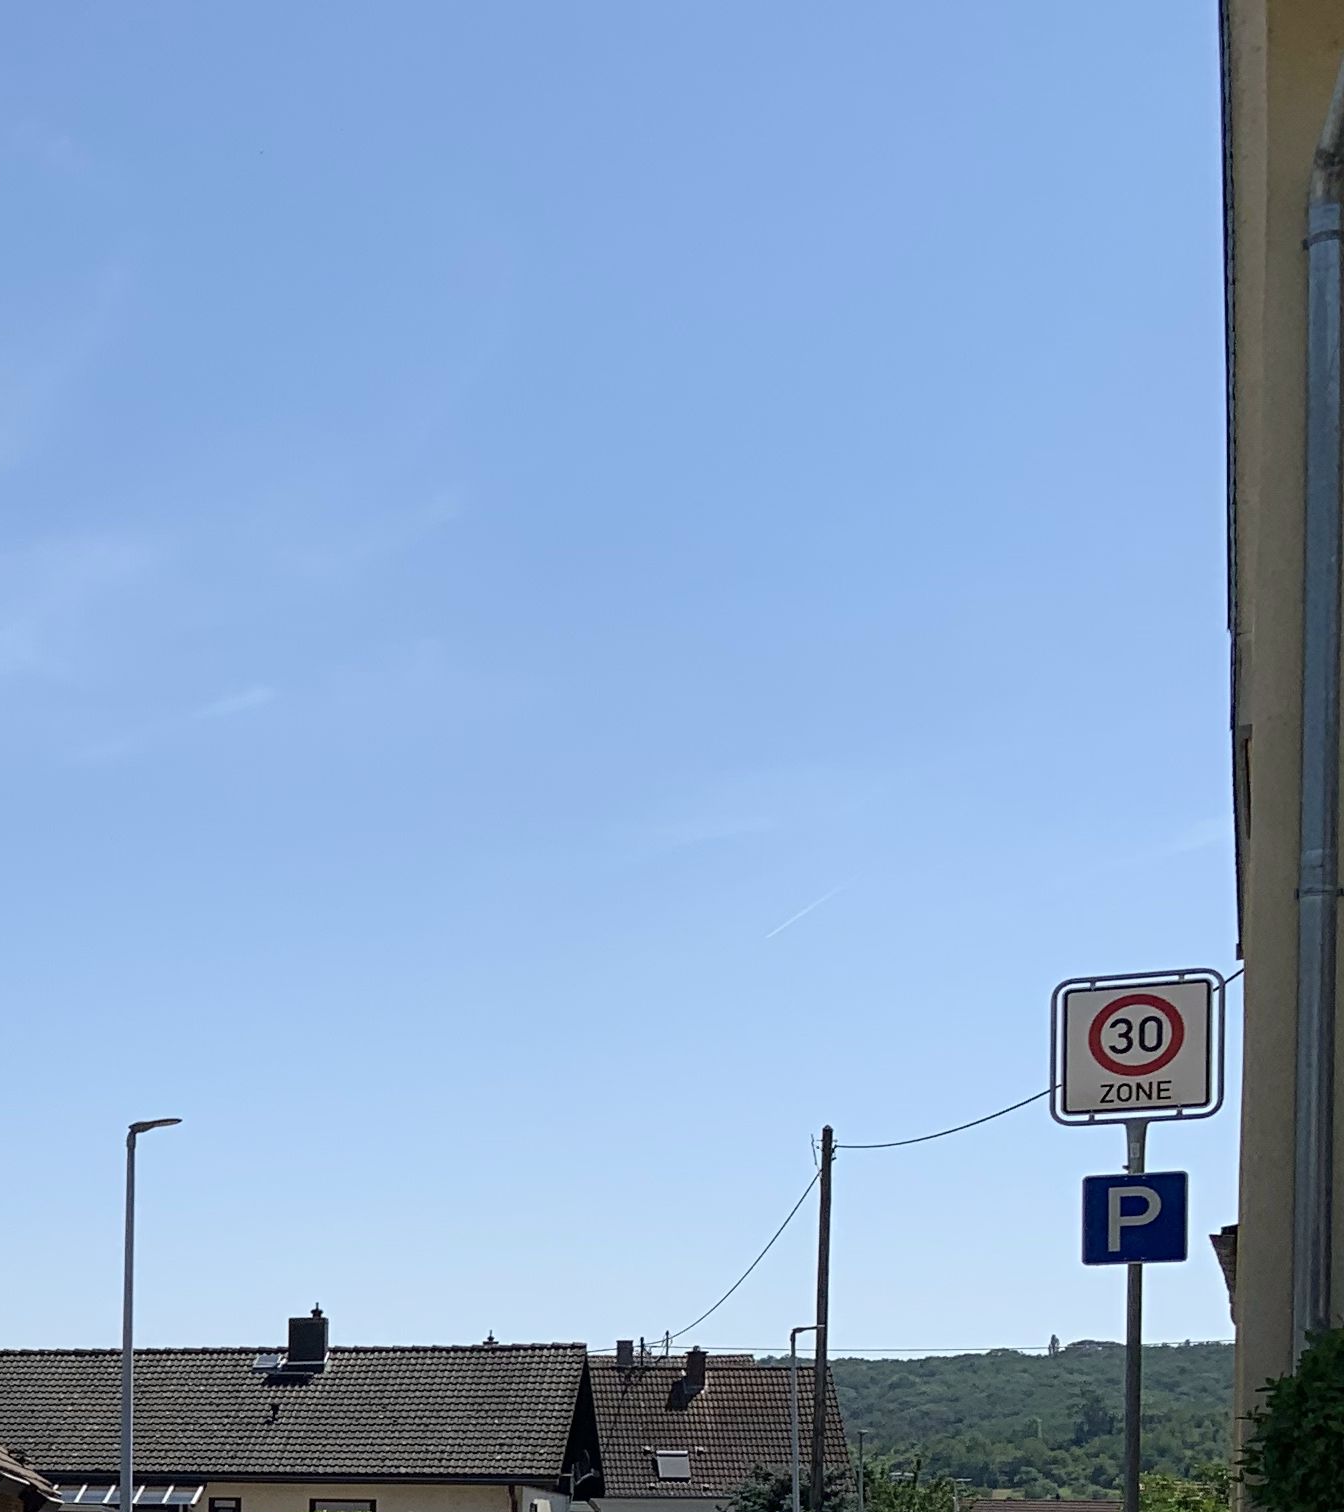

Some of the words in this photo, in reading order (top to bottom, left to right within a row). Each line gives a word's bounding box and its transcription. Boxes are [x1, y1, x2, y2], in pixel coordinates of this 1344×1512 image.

[1109, 1015, 1163, 1054] 30
[1099, 1080, 1172, 1103] ZONE
[1108, 1186, 1162, 1252] P
